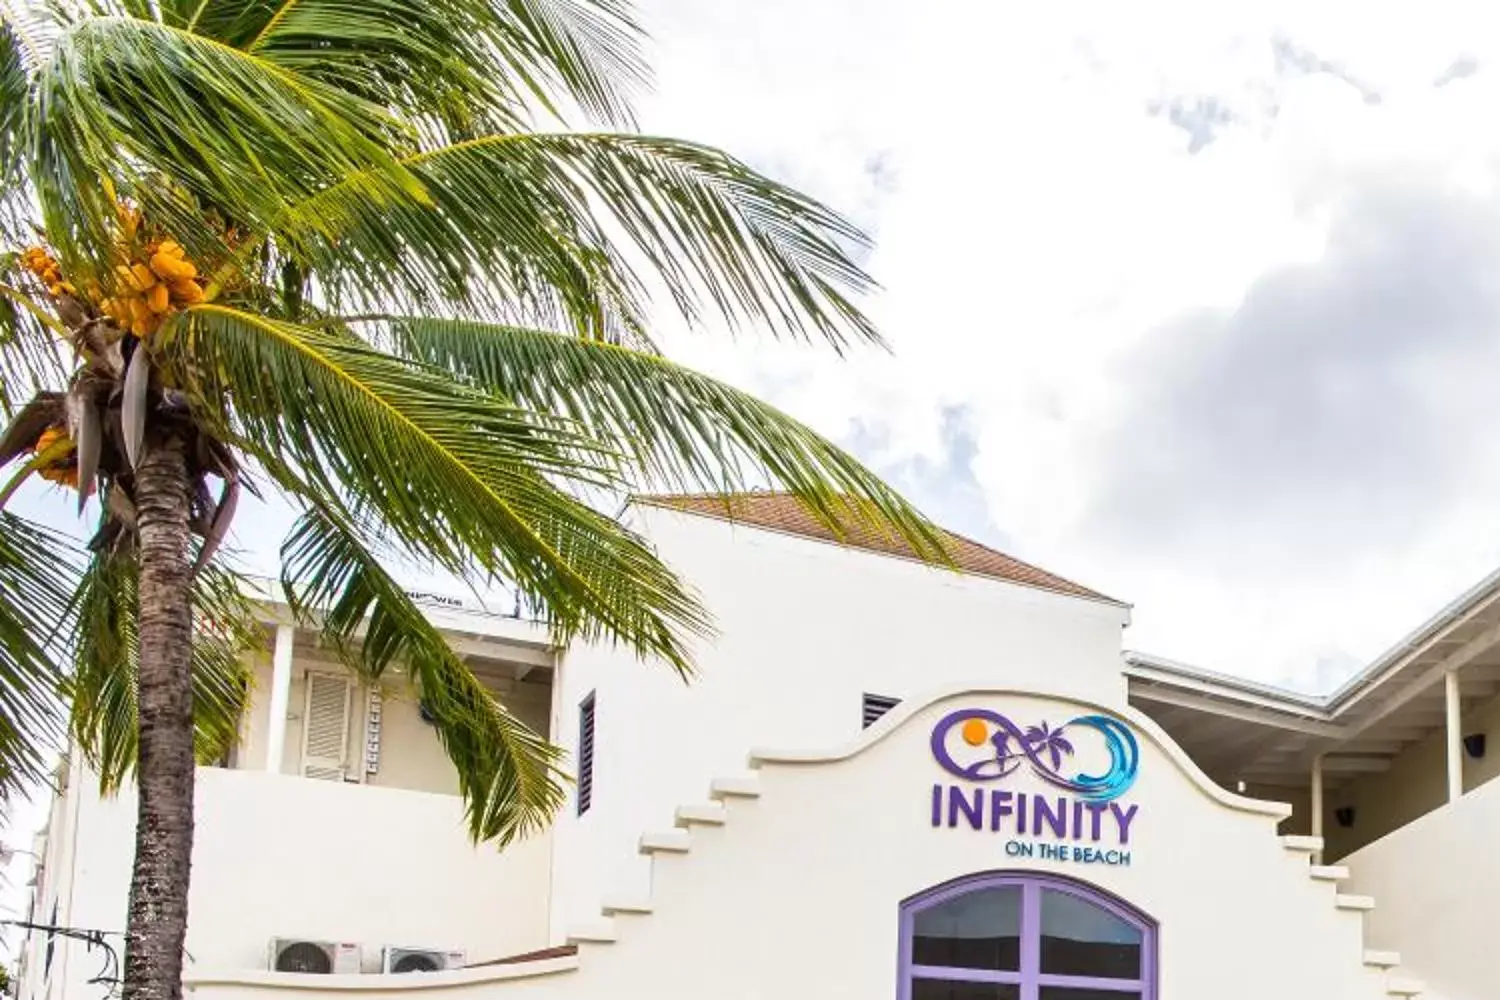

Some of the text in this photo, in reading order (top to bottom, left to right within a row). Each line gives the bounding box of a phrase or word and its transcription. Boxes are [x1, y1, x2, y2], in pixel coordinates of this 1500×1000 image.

[931, 784, 1139, 845] INFINITY
[1004, 840, 1132, 867] ON THE BEACH
